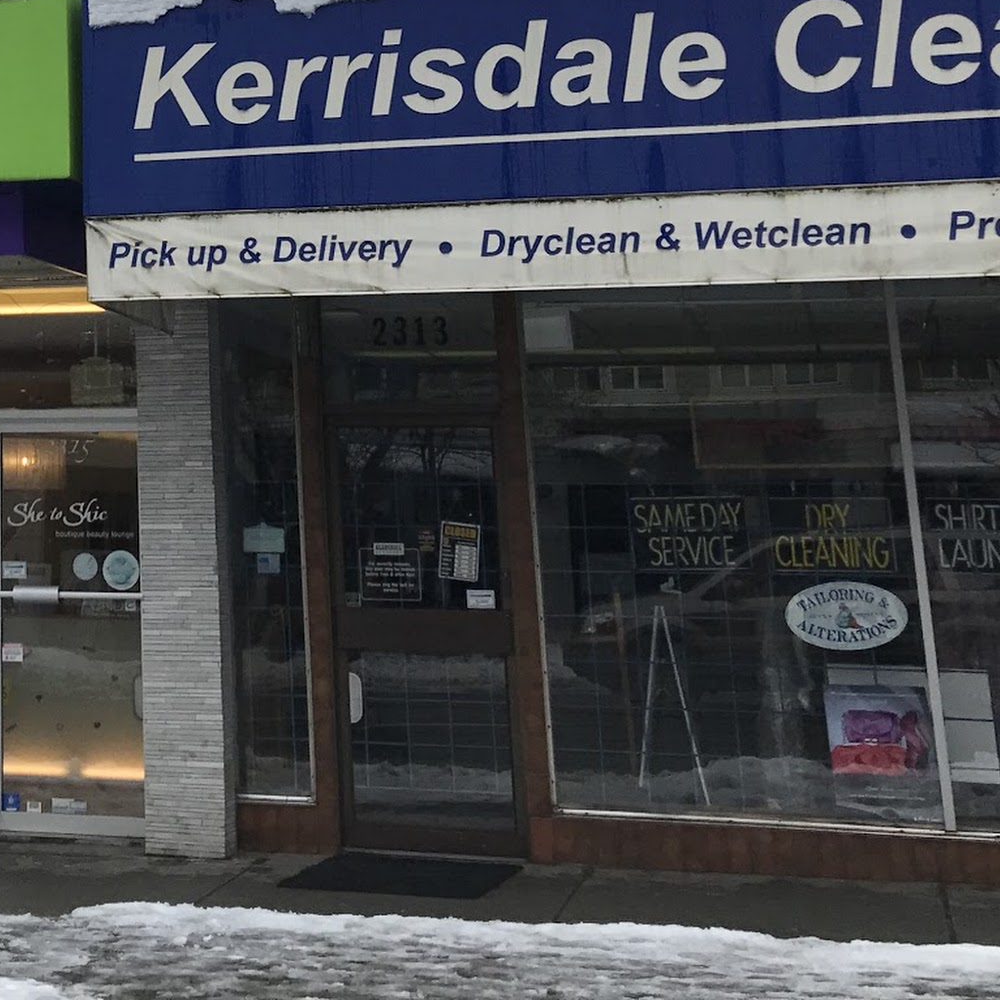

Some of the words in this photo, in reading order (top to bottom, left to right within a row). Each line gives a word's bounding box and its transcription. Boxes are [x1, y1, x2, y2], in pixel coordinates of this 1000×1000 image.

[133, 12, 727, 130] Kerrisdale
[949, 210, 1000, 241] Pr
[109, 241, 176, 269] Pick
[188, 243, 227, 272] up
[239, 237, 261, 264] &
[273, 235, 412, 269] Delivery
[481, 227, 640, 265] Dryclean
[656, 222, 680, 251] &
[694, 218, 871, 250] Wetclean
[372, 316, 448, 346] 2313
[7, 498, 46, 527] She
[50, 507, 63, 521] to
[63, 498, 108, 527] Shic
[805, 503, 850, 534] DRY
[649, 536, 737, 566] SERVICE
[775, 535, 890, 569] CLEANING
[797, 587, 875, 612] TAILORING
[879, 597, 891, 610] &
[797, 616, 898, 643] ALTERATIONS
